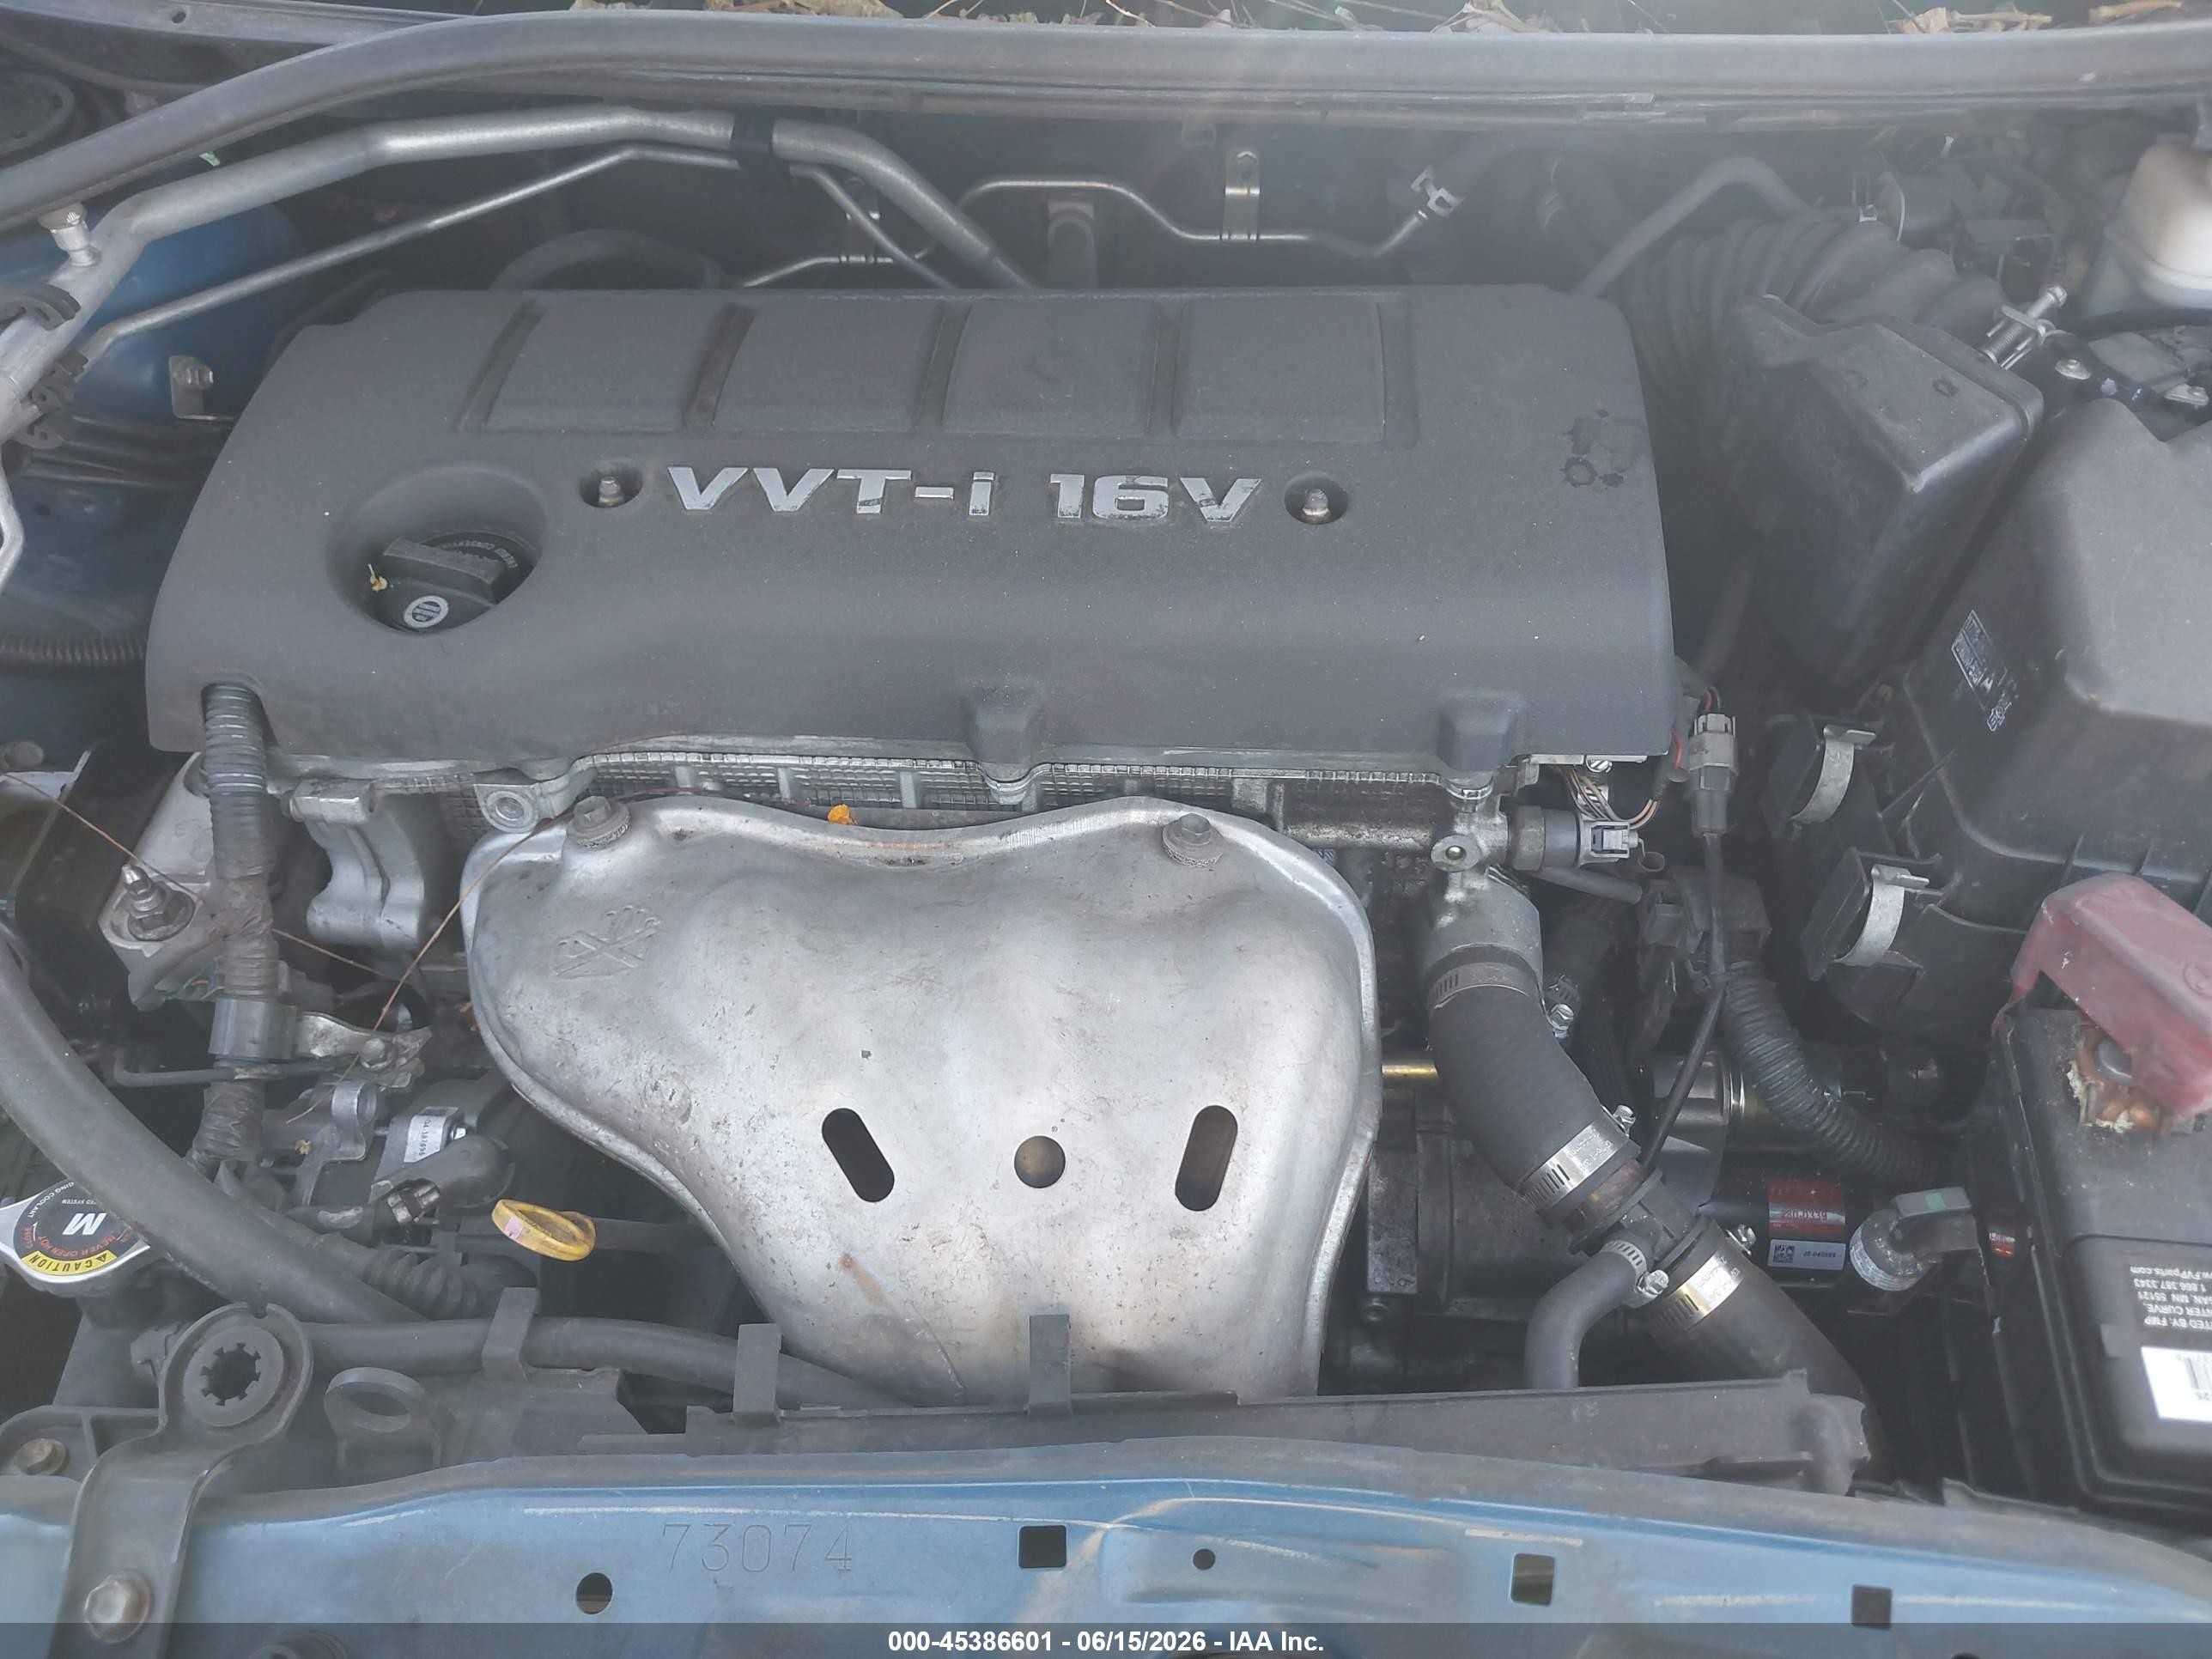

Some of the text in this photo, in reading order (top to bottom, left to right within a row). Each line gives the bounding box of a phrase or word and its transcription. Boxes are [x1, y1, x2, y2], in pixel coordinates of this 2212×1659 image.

[667, 466, 1261, 522] VVT-i 16V
[27, 1191, 56, 1218] COOLANT
[62, 1212, 107, 1236] M
[38, 1236, 54, 1251] HOT
[53, 1247, 80, 1258] OPEN
[82, 1236, 117, 1256] NEVER
[29, 1254, 93, 1272] CAUTION
[662, 1523, 853, 1573] 73074
